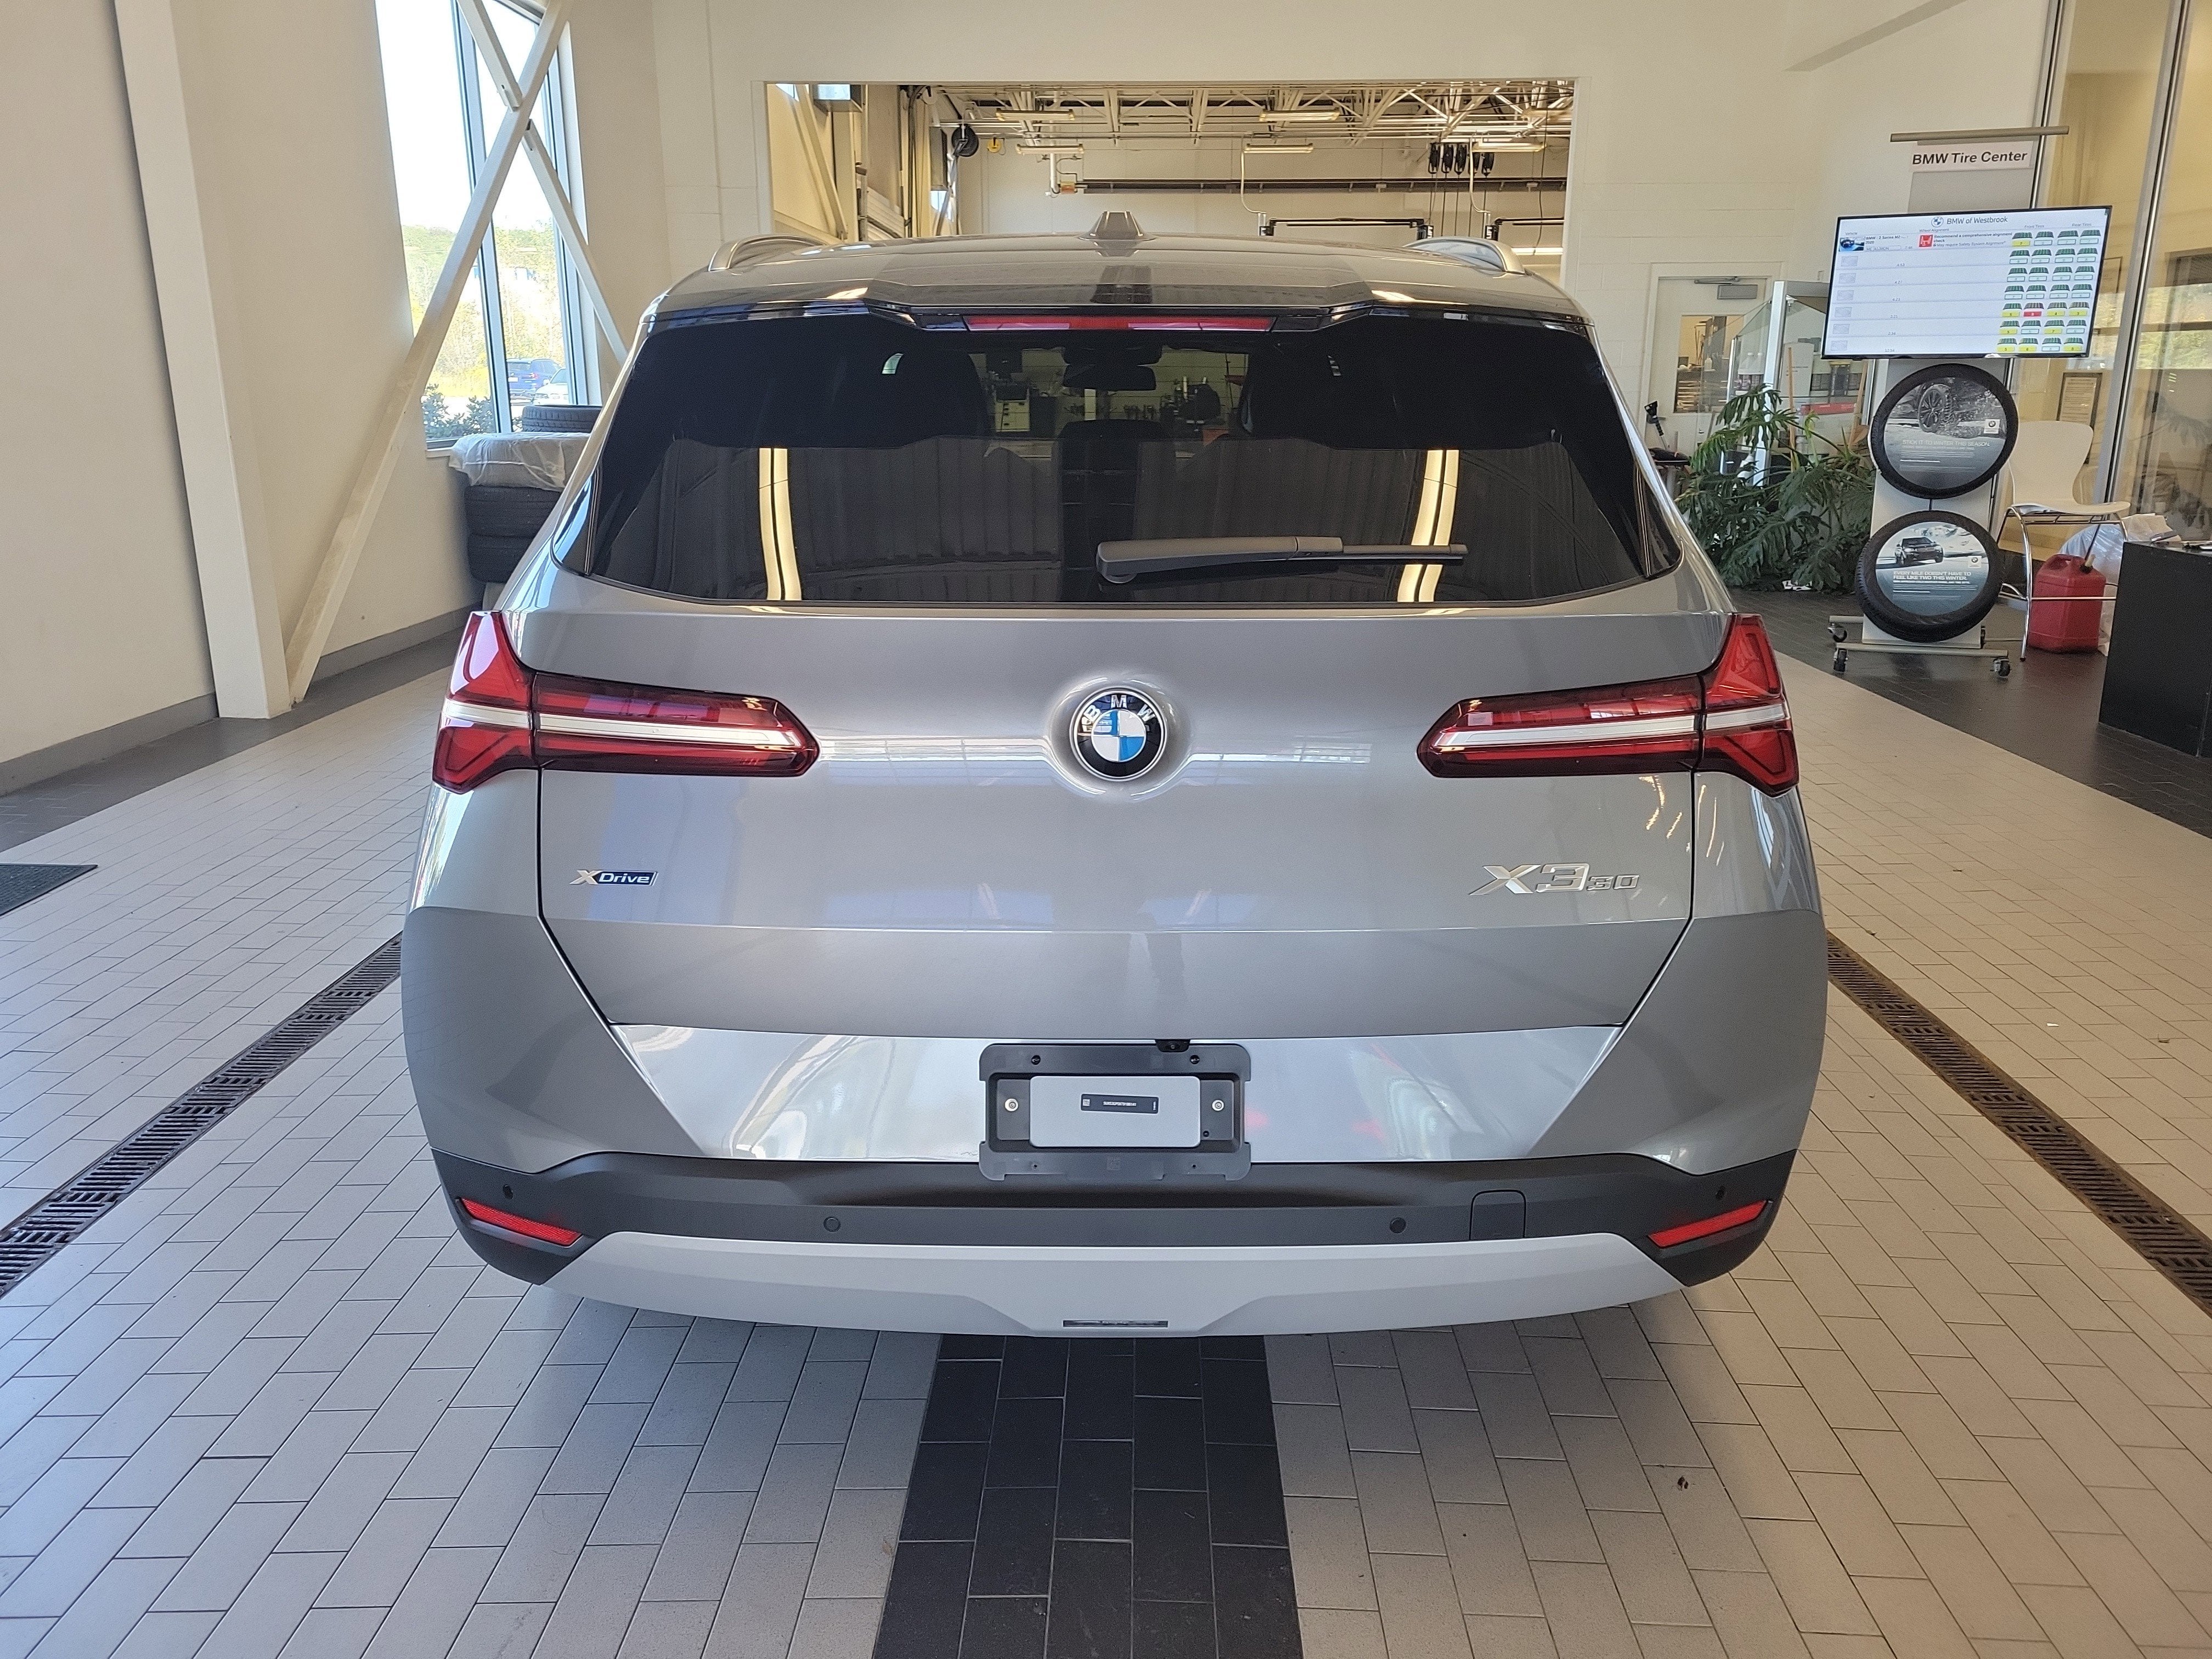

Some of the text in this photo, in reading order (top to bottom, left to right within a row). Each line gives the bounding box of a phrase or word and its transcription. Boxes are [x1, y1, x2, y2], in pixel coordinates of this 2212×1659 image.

[1912, 151, 2028, 165] BMW Tire Center
[1084, 695, 1156, 723] BMW
